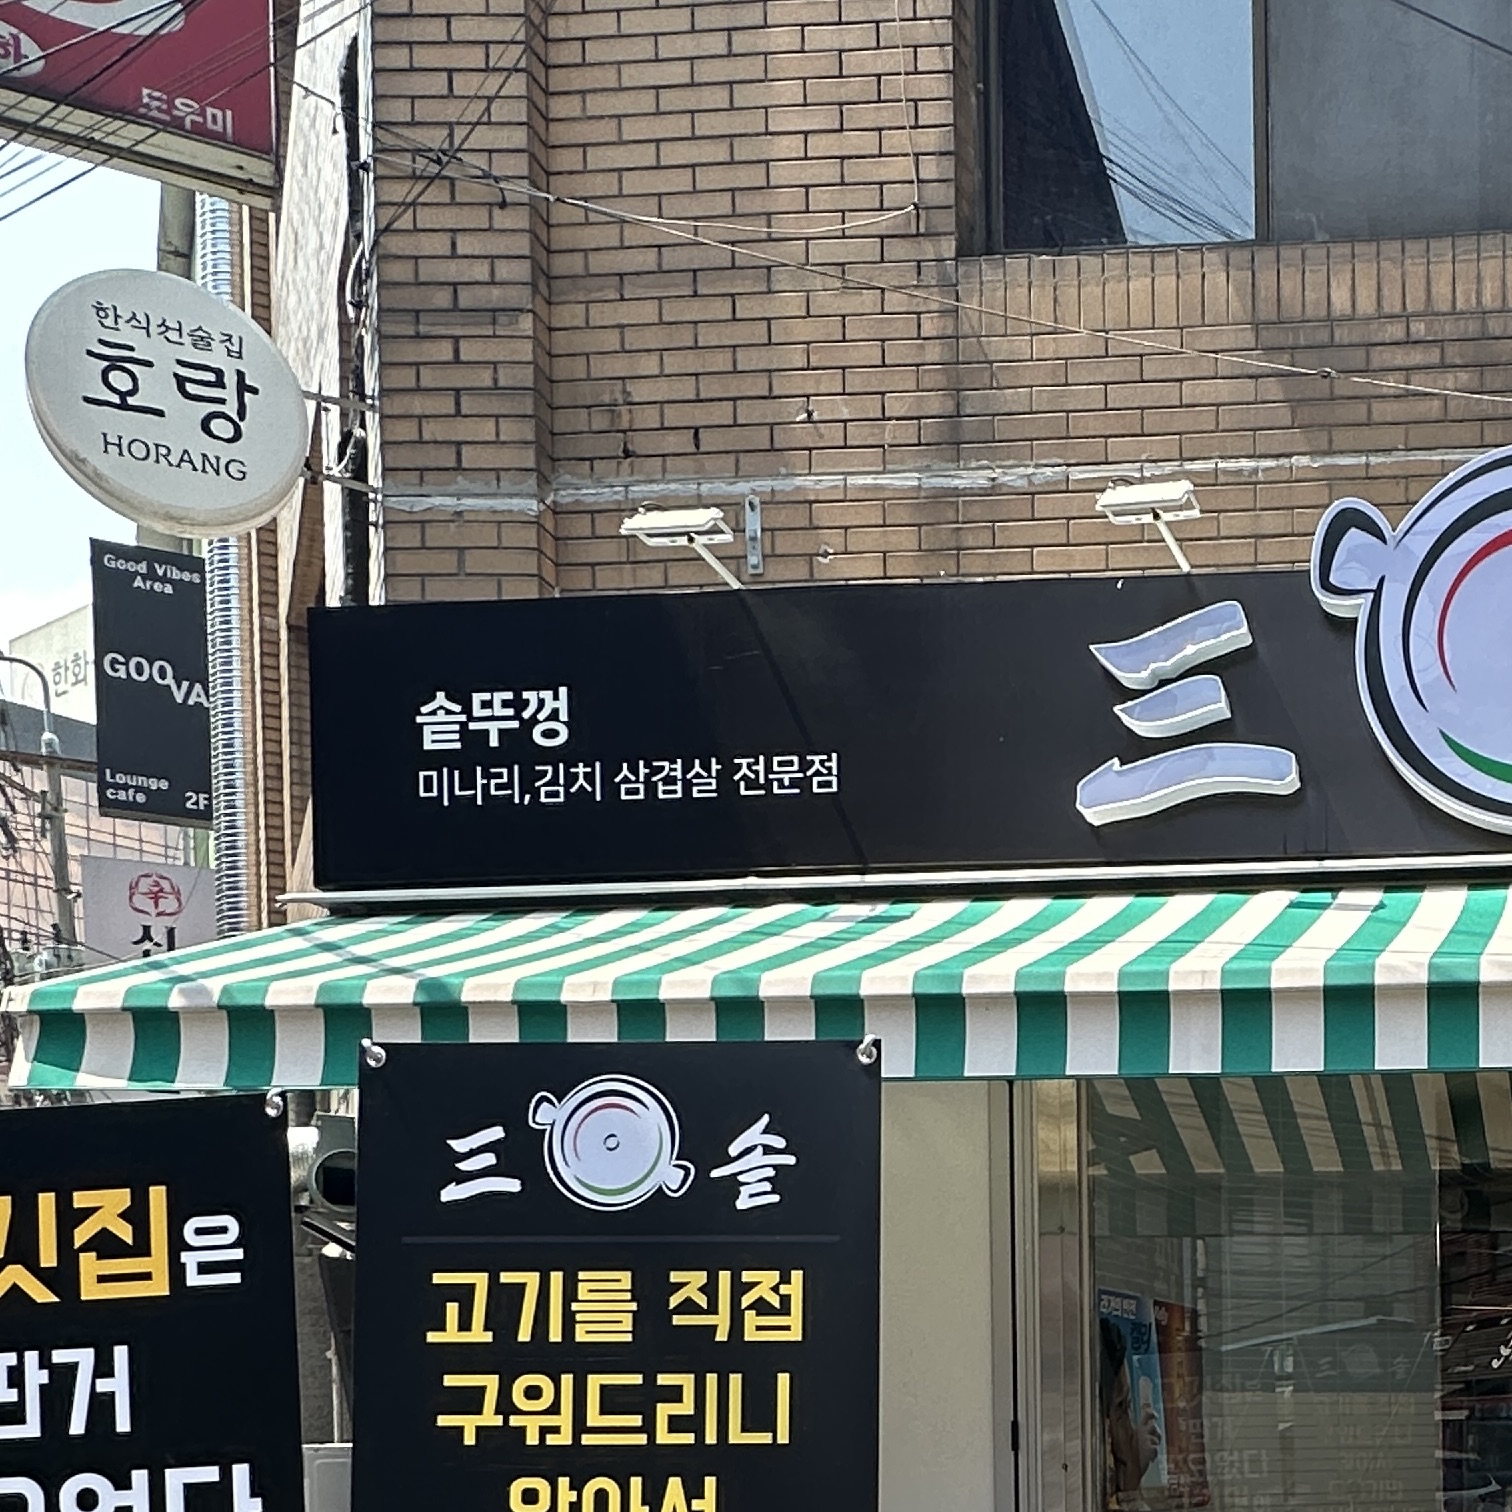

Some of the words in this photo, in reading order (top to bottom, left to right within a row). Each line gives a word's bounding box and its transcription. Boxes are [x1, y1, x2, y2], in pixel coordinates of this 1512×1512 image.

[92, 300, 244, 360] 한식선술집
[82, 338, 260, 444] 호랑
[101, 432, 248, 482] HORANG
[103, 554, 148, 575] Good
[154, 562, 201, 584] Vibes
[133, 575, 174, 595] Area
[51, 655, 95, 698] 한화
[416, 687, 568, 749] 솥뚜껑
[105, 768, 170, 791] Lounge
[106, 787, 148, 805] cafe
[184, 792, 209, 811] 2F
[419, 761, 601, 806] 미나리,김치
[614, 758, 721, 800] 삼겹살
[733, 753, 837, 795] 전문점
[427, 1271, 637, 1342] 고기를
[669, 1270, 803, 1341] 직접
[436, 1373, 789, 1445] 구워드리니
